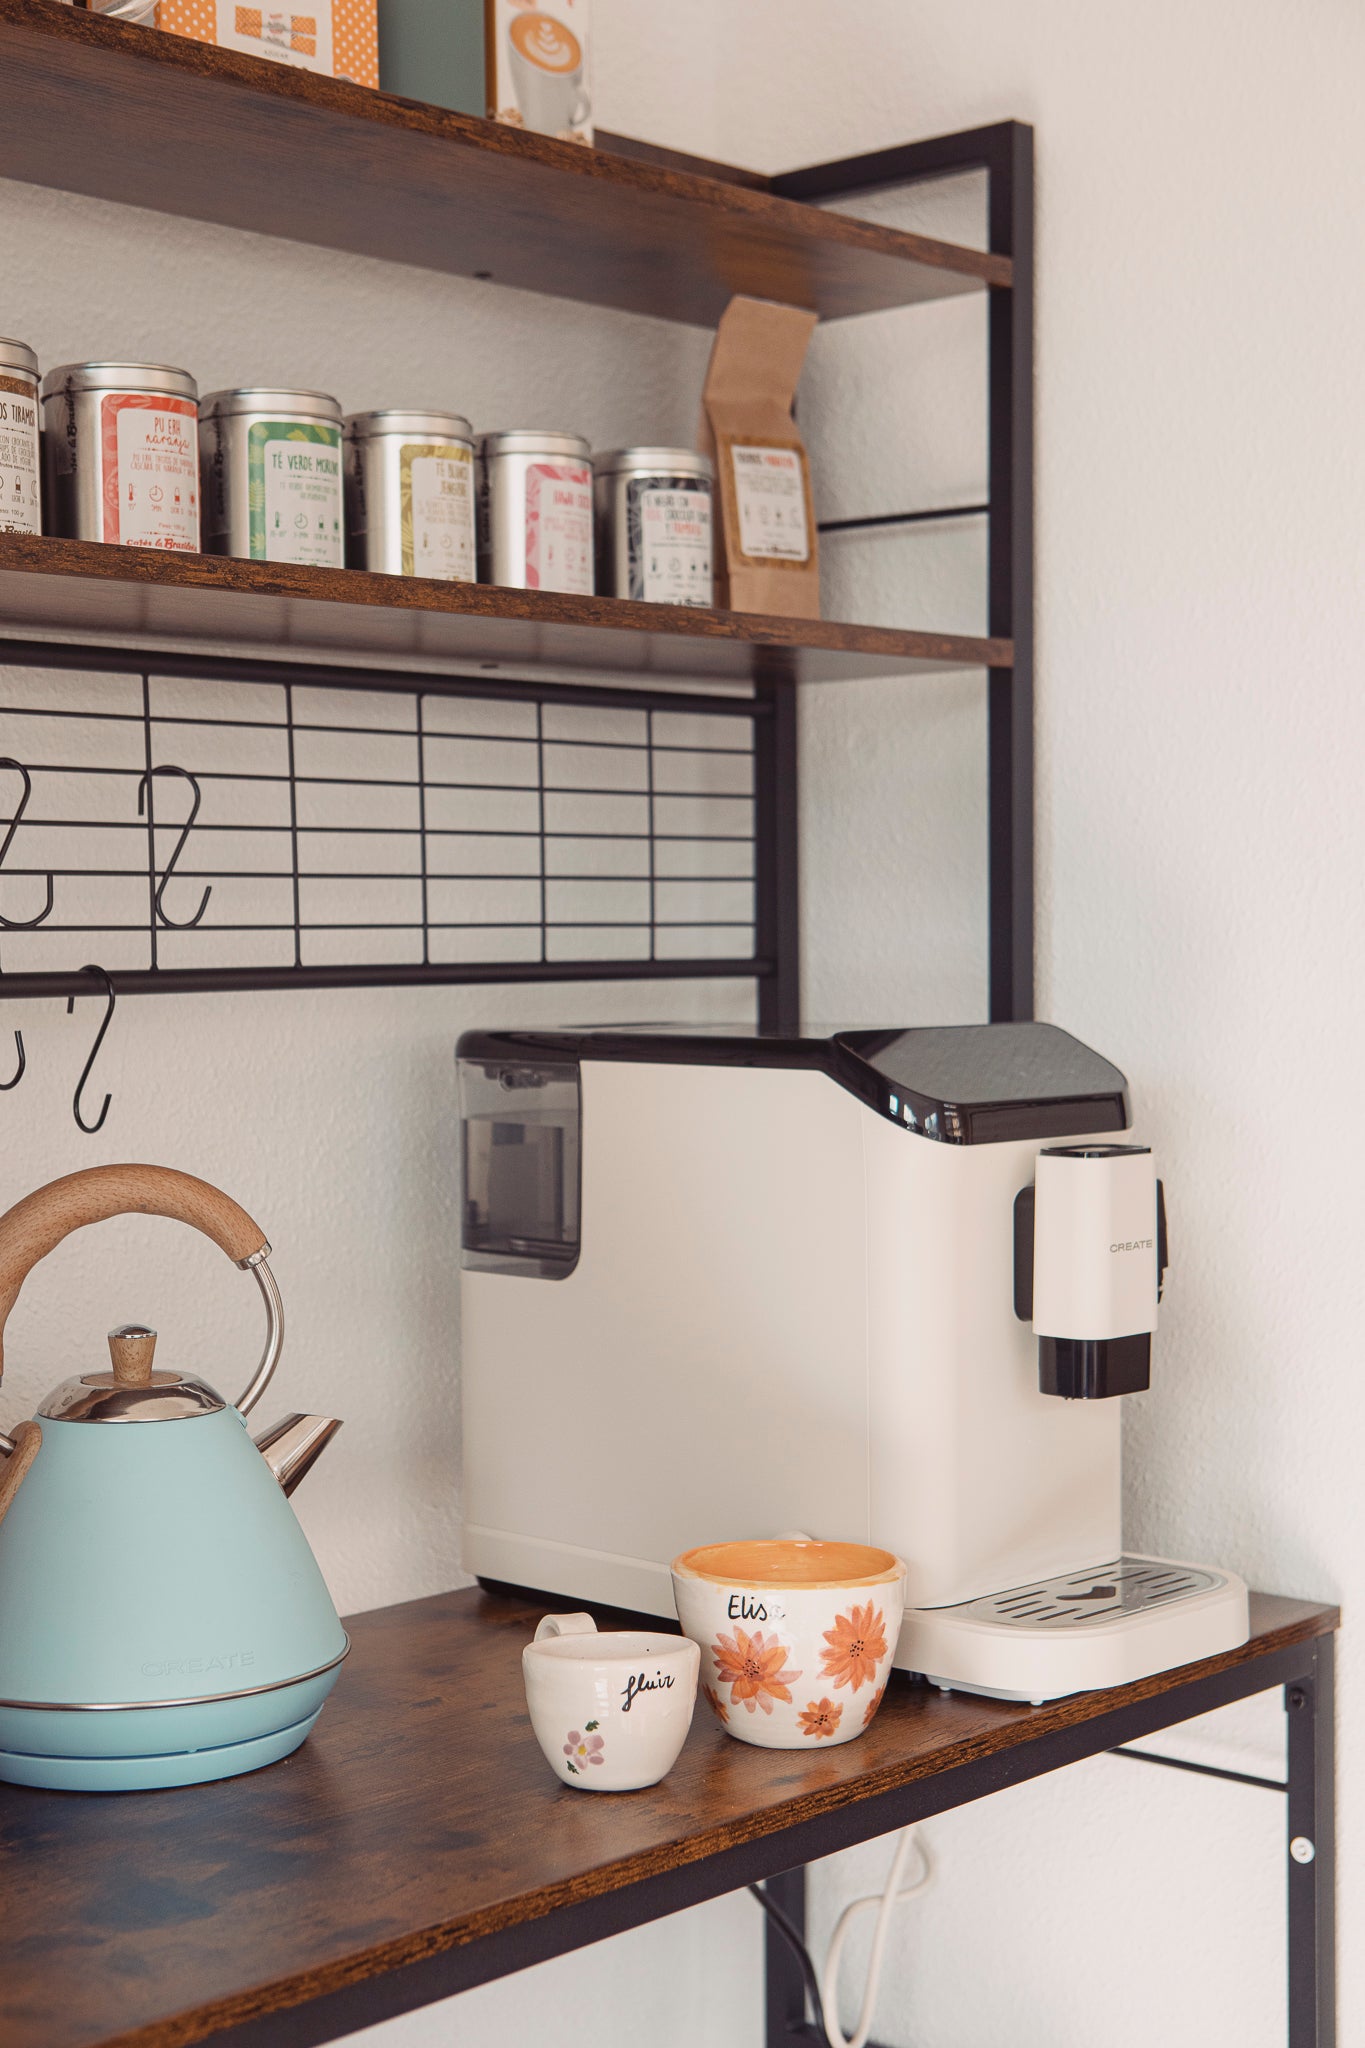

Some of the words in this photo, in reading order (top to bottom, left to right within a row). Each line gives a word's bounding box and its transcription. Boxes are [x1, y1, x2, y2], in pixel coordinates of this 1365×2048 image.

[154, 416, 165, 433] PU
[272, 450, 282, 469] TÉ
[287, 454, 312, 471] VERDE
[1109, 1239, 1153, 1253] CREATE
[140, 1650, 255, 1678] CREATE
[620, 1670, 676, 1713] fluir
